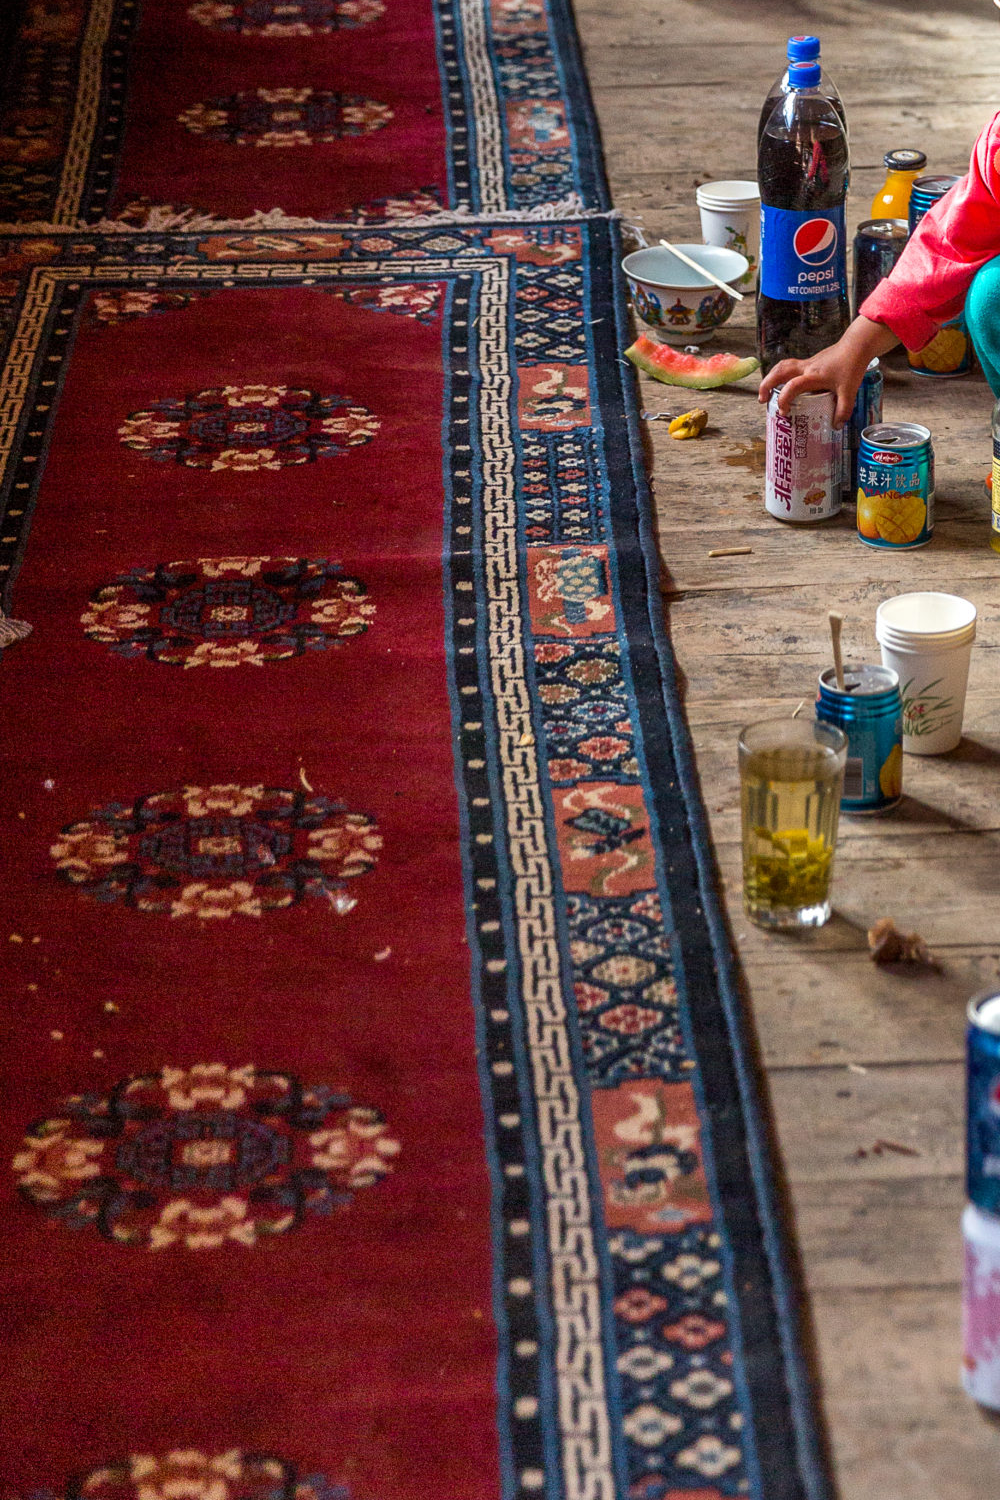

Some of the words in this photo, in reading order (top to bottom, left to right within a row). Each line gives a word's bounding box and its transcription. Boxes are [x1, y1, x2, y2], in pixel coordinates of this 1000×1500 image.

[798, 267, 834, 284] pepsi
[787, 286, 798, 294] NET
[799, 285, 826, 295] CONTENT
[859, 466, 920, 489] 芒果汁饮品
[865, 486, 913, 500] MANGO
